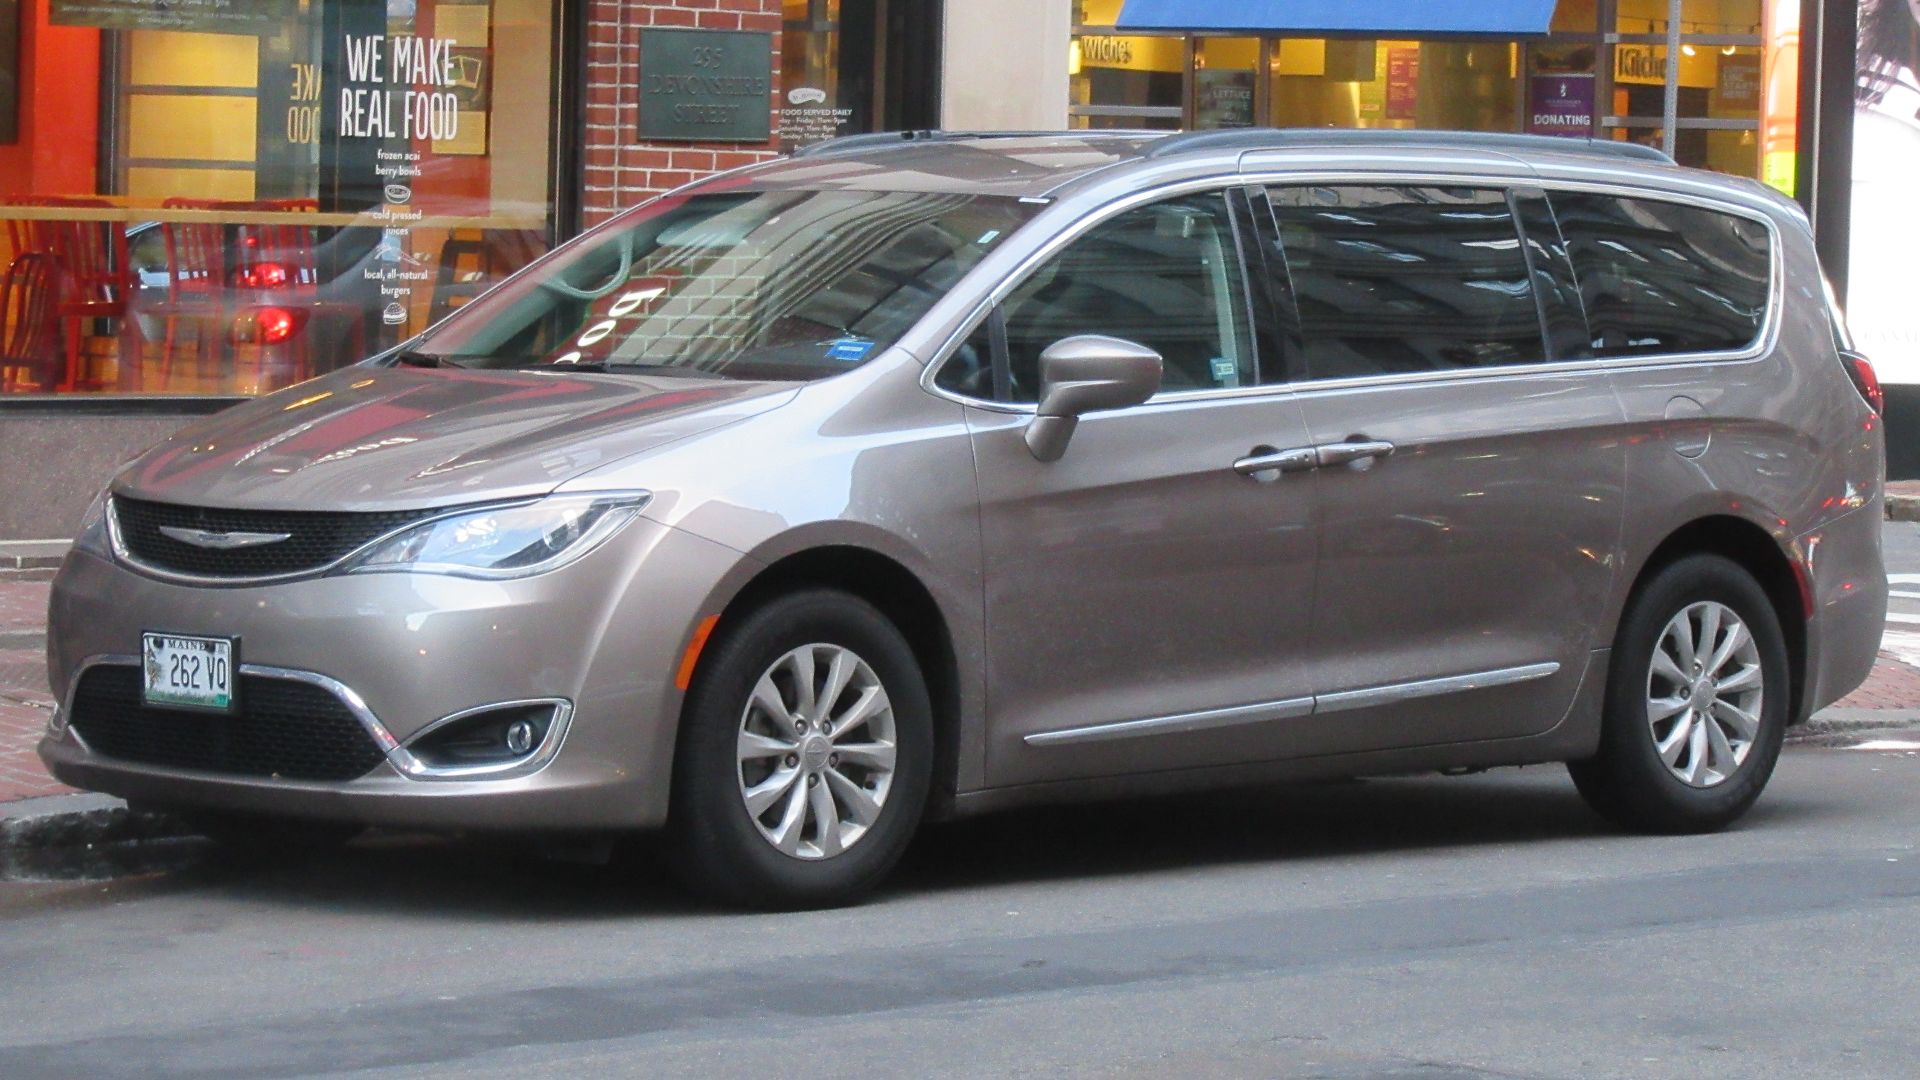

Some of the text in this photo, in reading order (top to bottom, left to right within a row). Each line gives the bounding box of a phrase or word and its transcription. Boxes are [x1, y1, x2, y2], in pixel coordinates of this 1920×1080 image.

[346, 34, 457, 86] WE MAKE
[648, 74, 764, 97] DEVONSHIRE
[341, 88, 457, 140] REAL FOOD
[674, 103, 739, 124] STREET
[1533, 114, 1591, 126] DONATING
[377, 148, 421, 160] frozen acai
[375, 164, 422, 179] berry bowls
[373, 208, 422, 223] cold pressed
[384, 225, 409, 238] juices
[364, 268, 428, 281] local, all-natural
[381, 284, 411, 299] burgers
[168, 640, 206, 651] MAINE
[171, 653, 226, 691] 262 VQ
